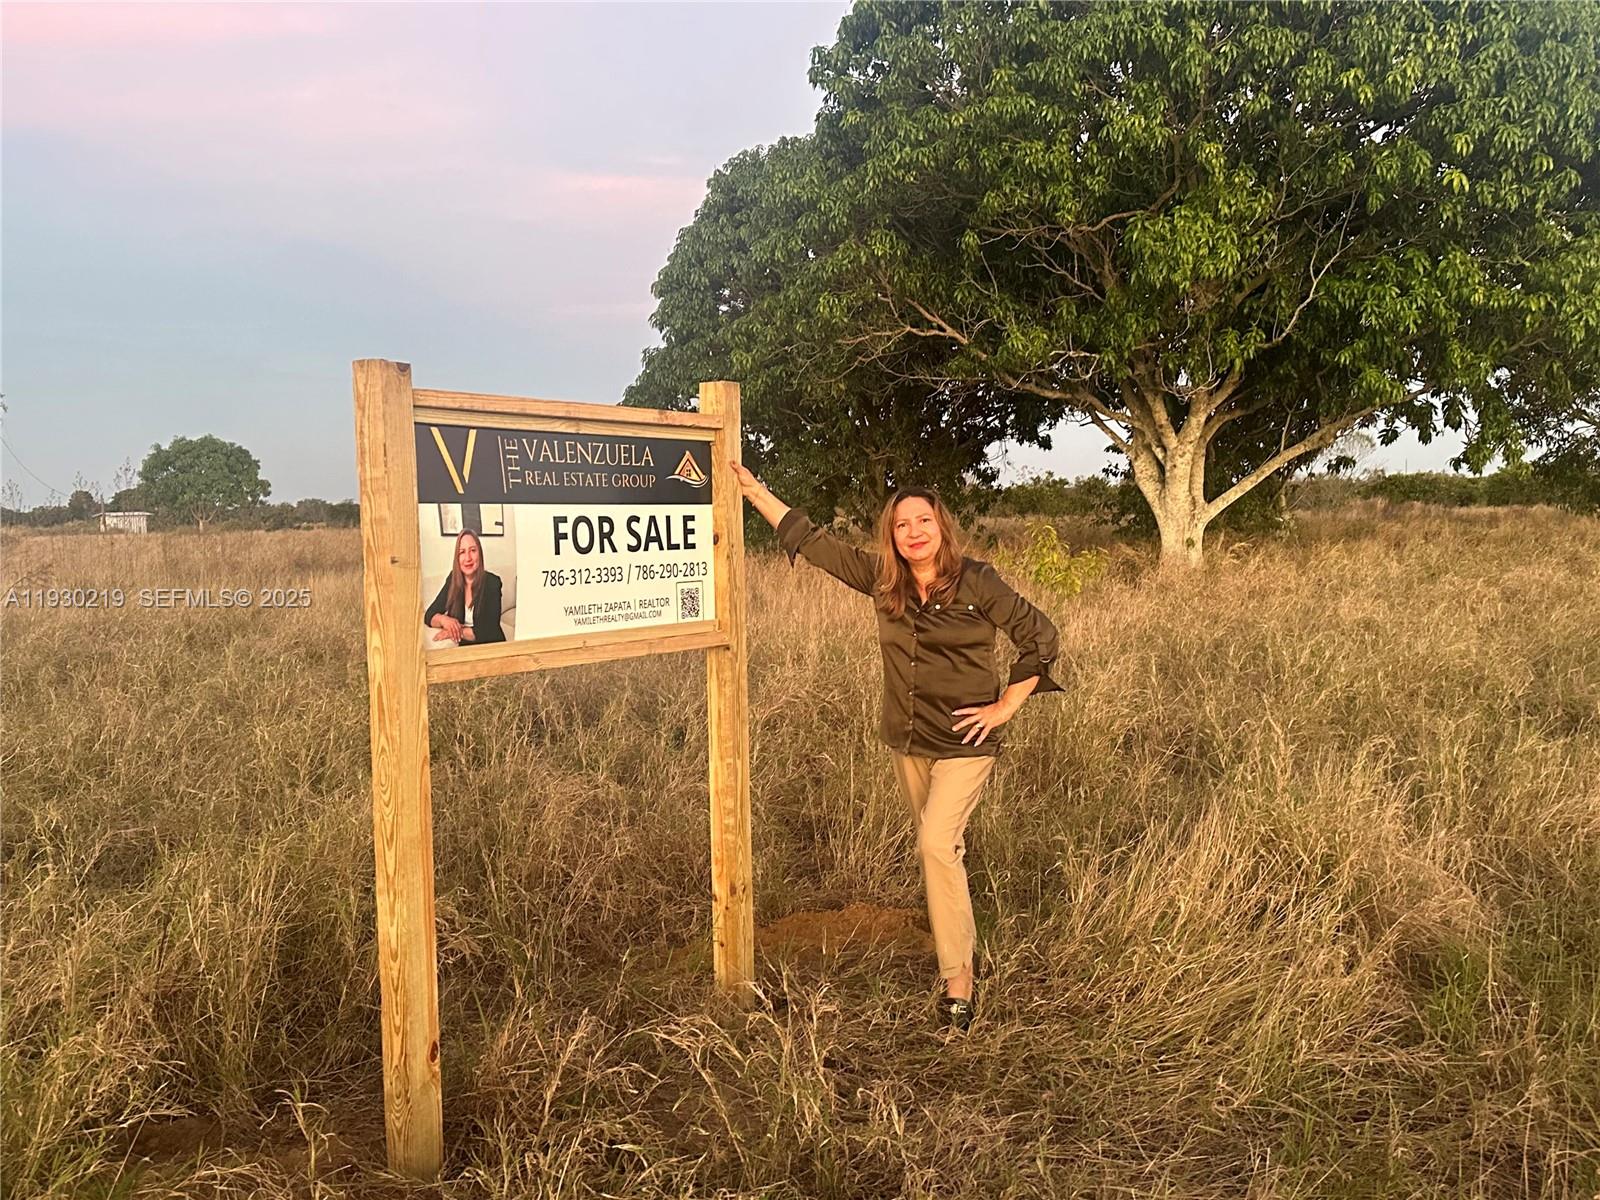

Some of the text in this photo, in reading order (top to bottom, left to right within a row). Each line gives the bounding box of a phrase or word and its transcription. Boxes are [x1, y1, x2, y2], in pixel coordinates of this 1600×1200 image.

[430, 427, 477, 494] V
[506, 438, 522, 488] THE
[521, 438, 654, 467] VALENZUELA
[525, 470, 656, 488] REAL ESTATE GROUP
[552, 514, 697, 556] FOR SALE
[542, 566, 623, 587] 786-312-3393
[635, 561, 708, 581] 786-290-2813
[564, 603, 602, 616] YAMILETH
[604, 601, 631, 612] ZAPATA
[639, 597, 670, 608] REALTOR
[574, 610, 662, 626] YAMILETHREALTY@GMAIL.COM
